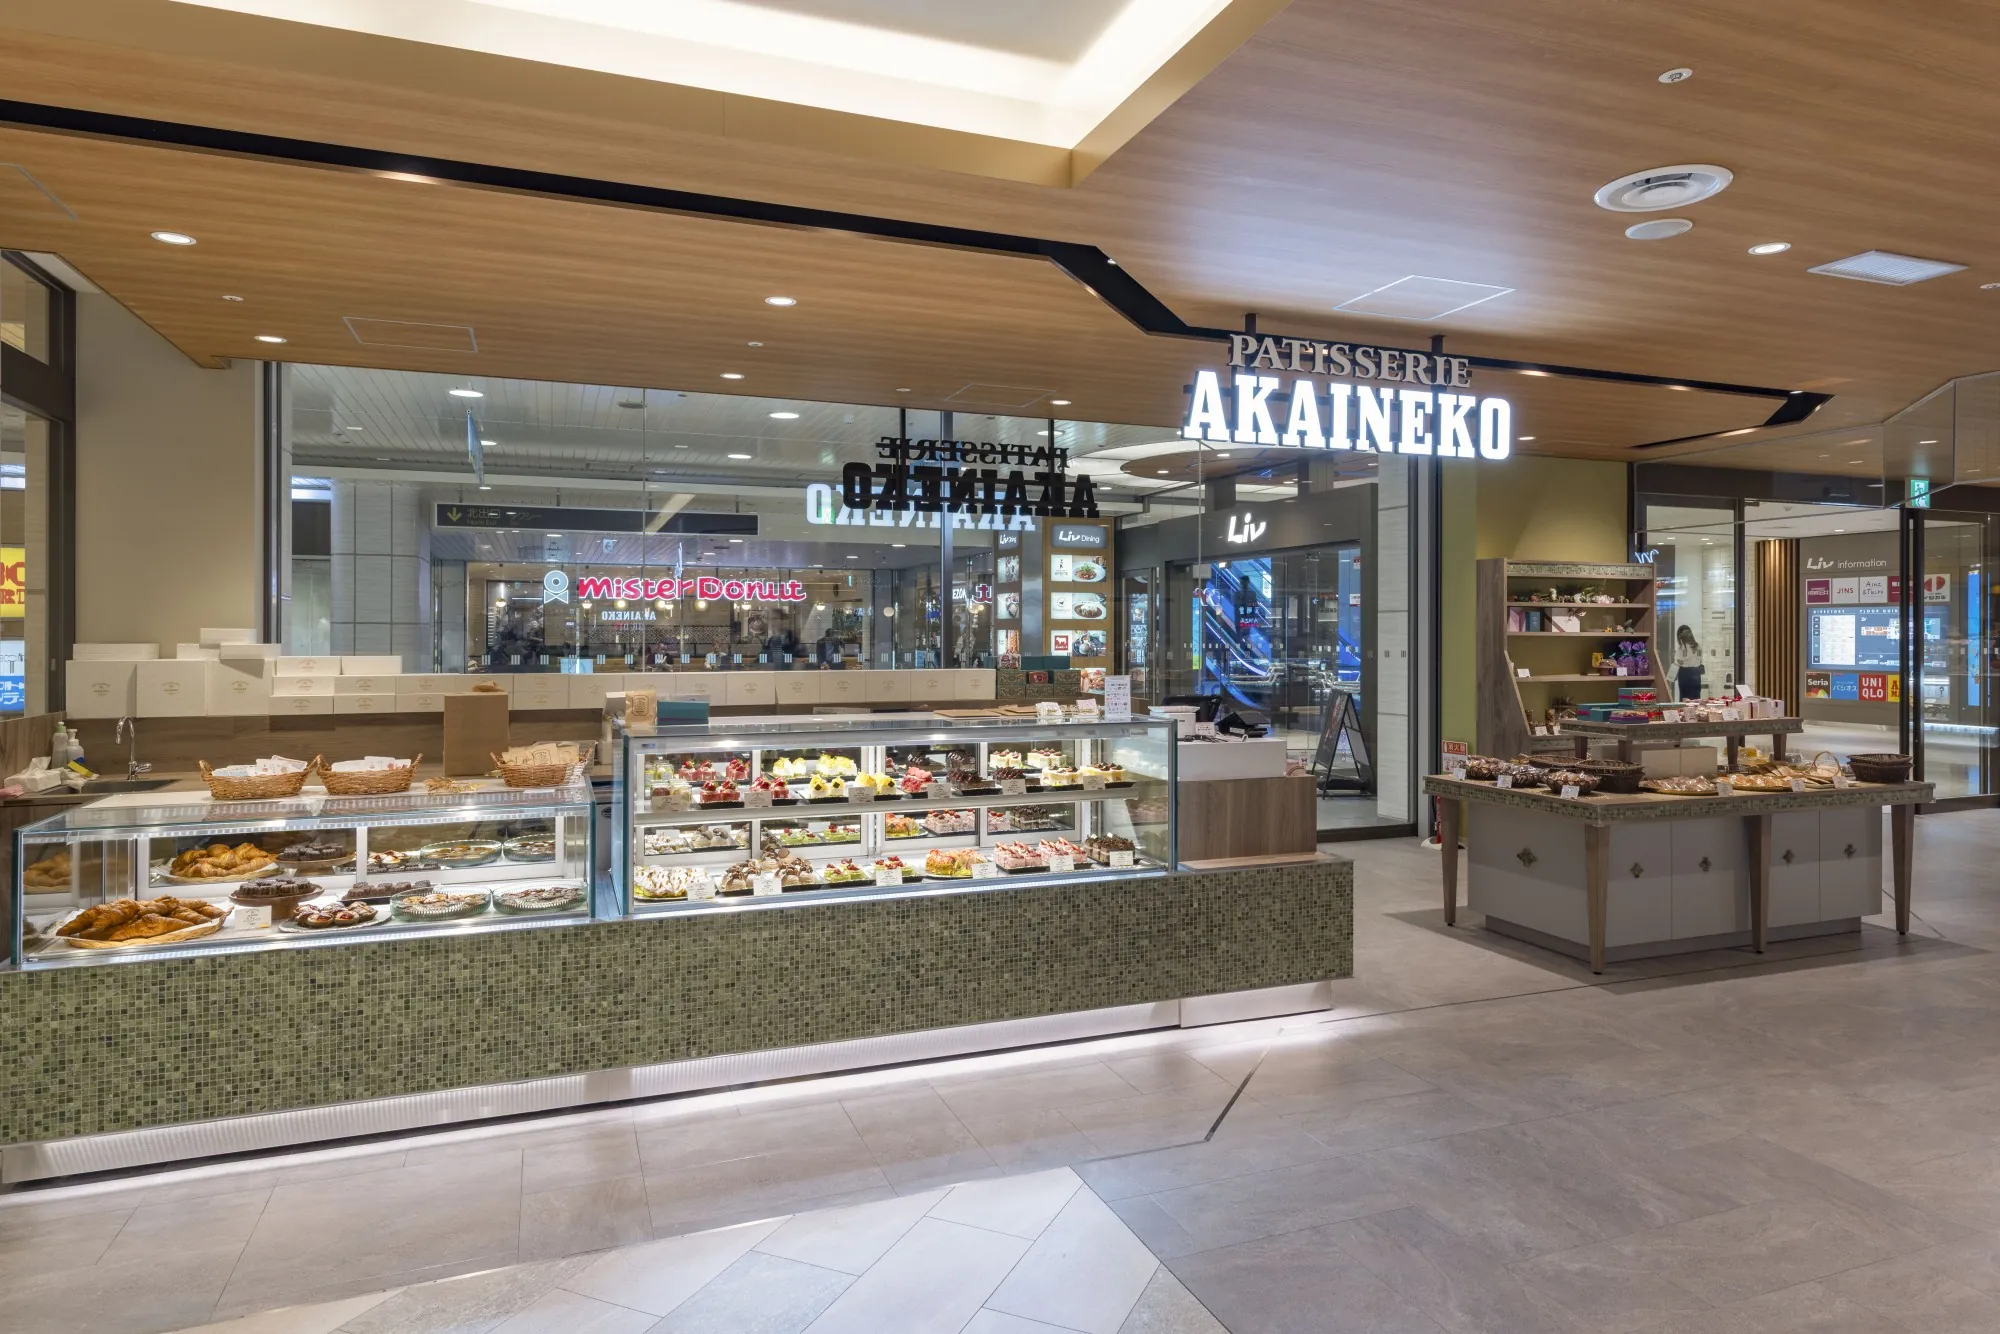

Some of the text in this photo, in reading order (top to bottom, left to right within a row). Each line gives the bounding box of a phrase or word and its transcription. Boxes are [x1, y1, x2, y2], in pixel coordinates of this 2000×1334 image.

[1229, 333, 1471, 388] PATISSERIE
[1181, 370, 1511, 460] AKAINEKO
[1227, 512, 1266, 544] Liv
[1059, 530, 1100, 544] Liv Dining
[1806, 556, 1887, 570] Liv information
[578, 576, 807, 601] Mister Donut
[1836, 587, 1854, 595] JINS
[1807, 678, 1829, 686] Seria
[1832, 684, 1858, 692] パシオス
[1862, 677, 1882, 687] UNI
[1862, 688, 1884, 699] QLO
